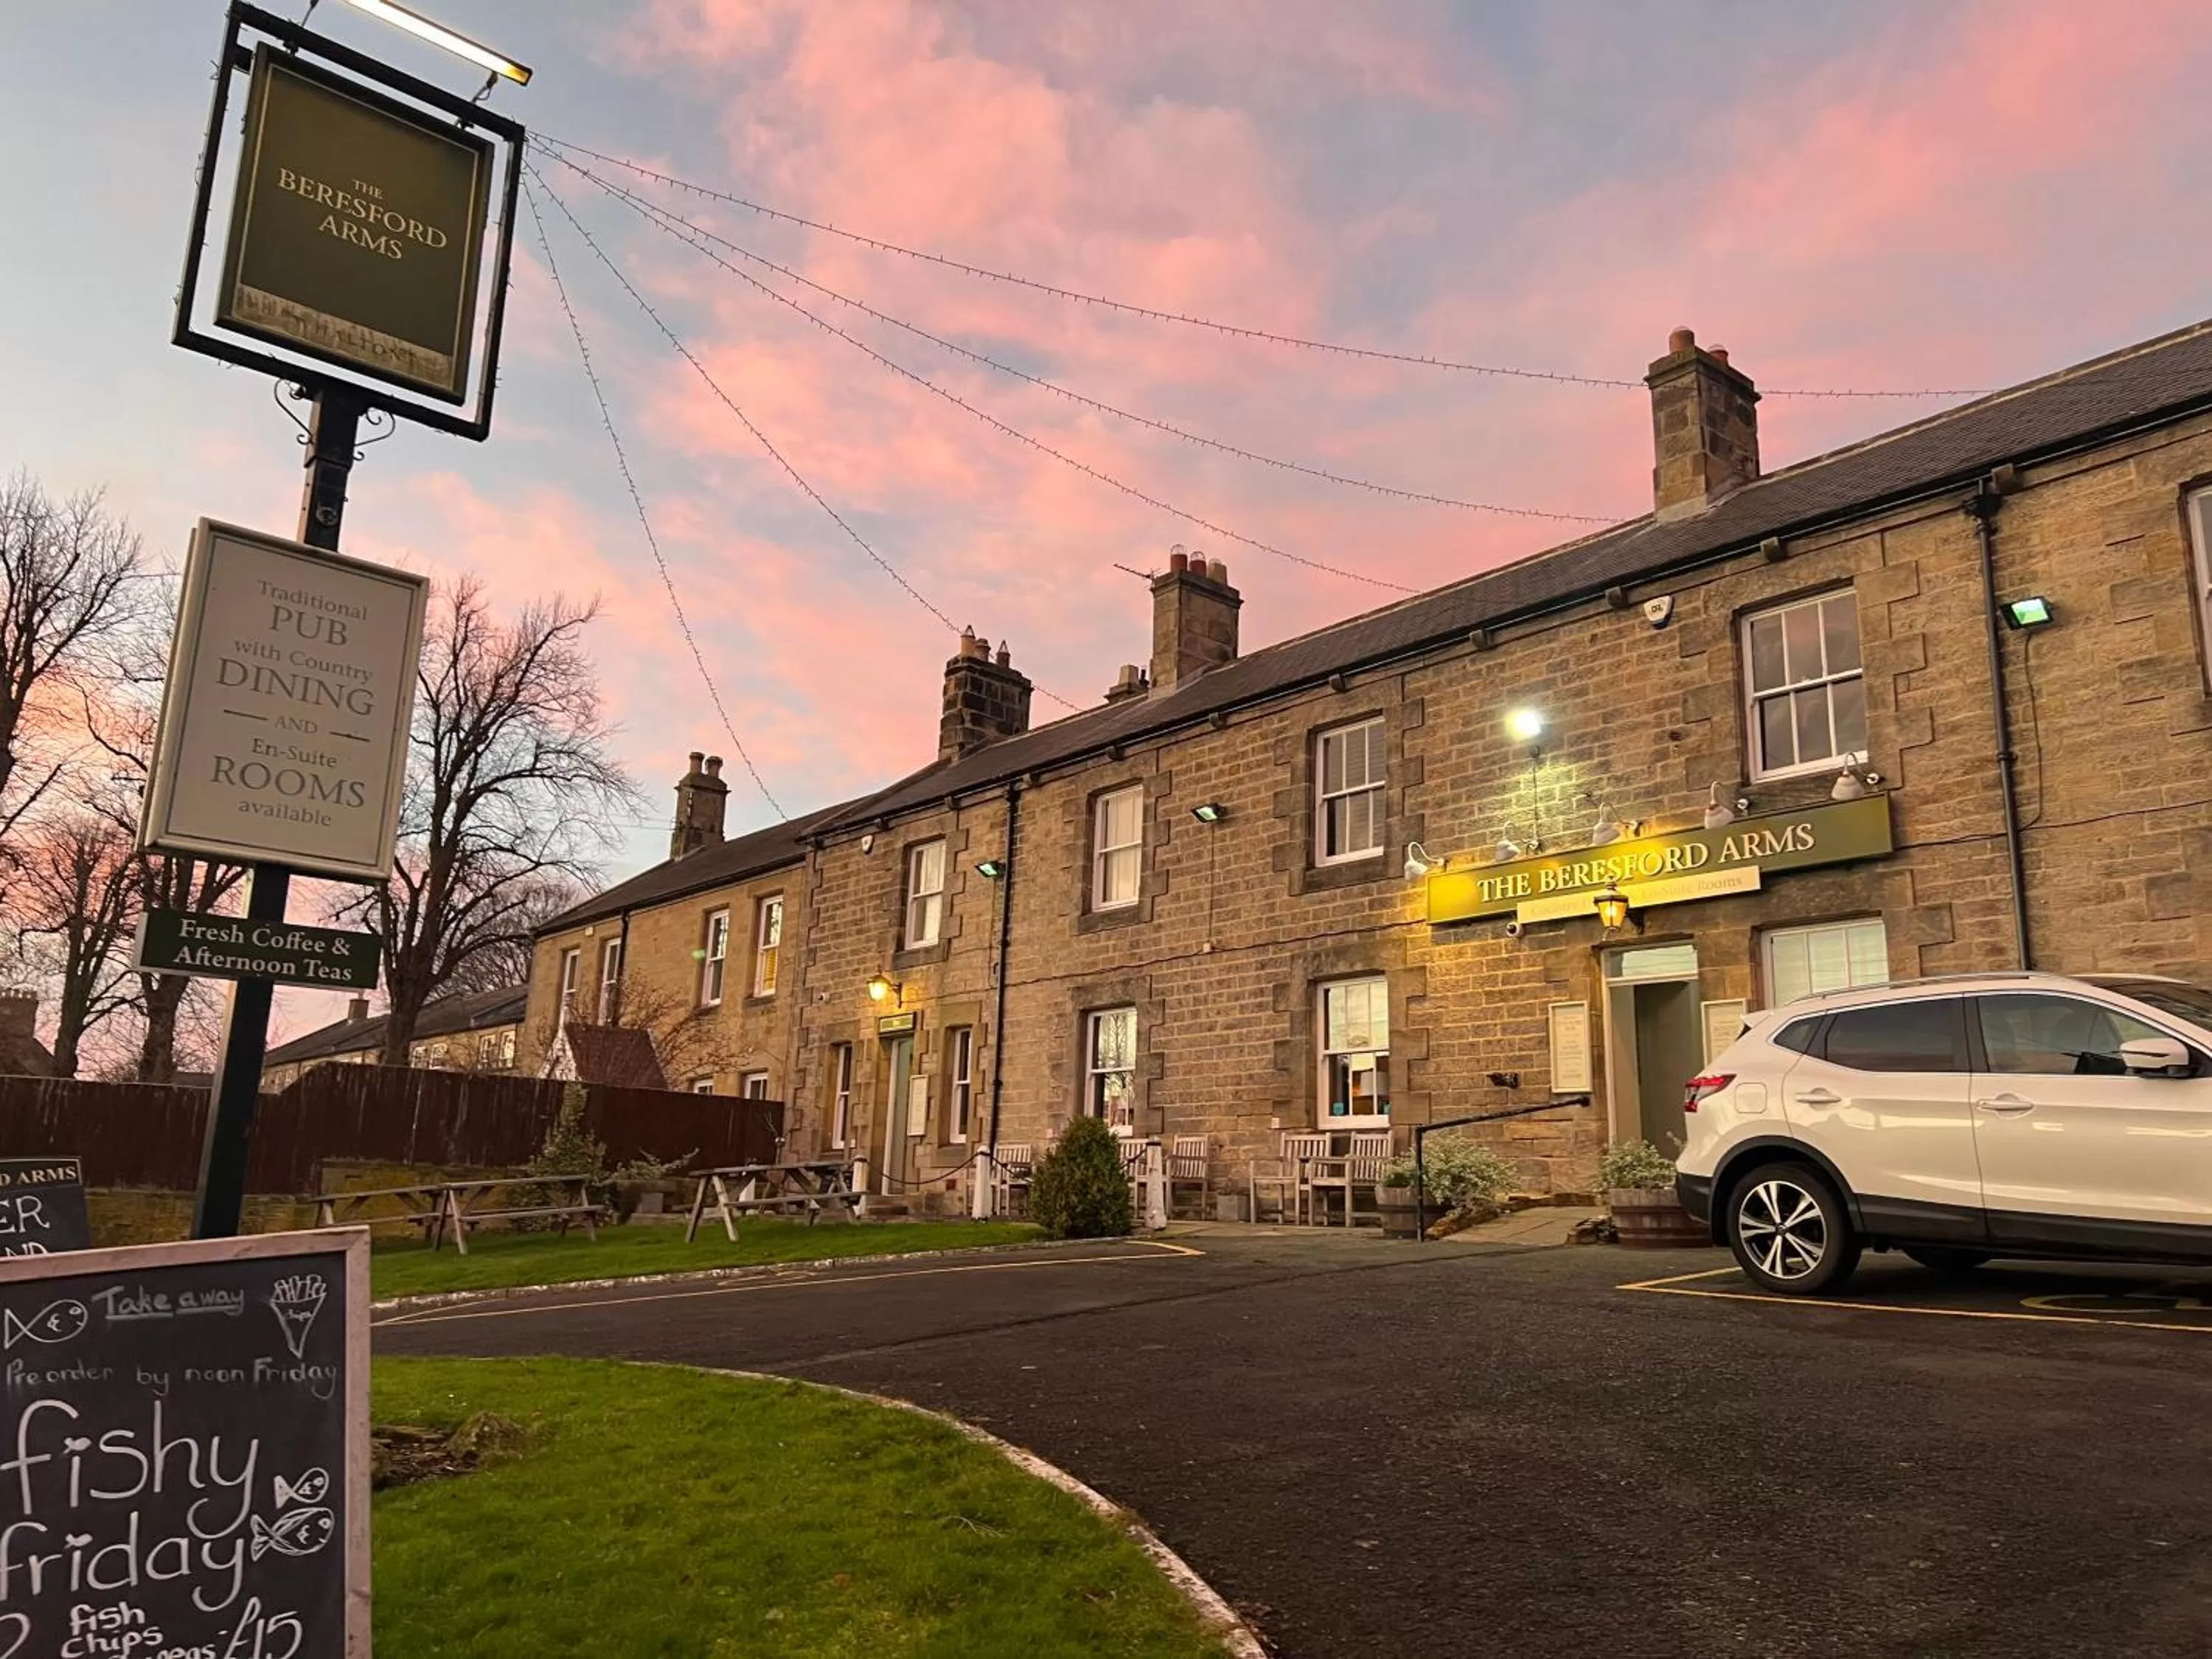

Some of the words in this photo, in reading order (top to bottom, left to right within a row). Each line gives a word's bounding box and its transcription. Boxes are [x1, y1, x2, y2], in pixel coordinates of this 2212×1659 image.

[277, 167, 448, 248] BERESFORD
[352, 178, 383, 199] THE
[318, 215, 403, 260] ARMS
[258, 580, 367, 621] Traditional
[270, 604, 347, 646] PUB
[235, 640, 281, 661] with
[289, 650, 373, 685] Country
[215, 656, 375, 716] DINING
[274, 715, 319, 734] AND
[251, 737, 337, 768] En-Suite
[210, 755, 366, 808] ROOMS
[237, 800, 331, 827] available
[1477, 872, 1532, 902] THE
[1539, 842, 1709, 894] BERESFORD
[1719, 822, 1815, 863] ARMS
[178, 918, 244, 944] Fresh
[251, 928, 326, 953] Coffee
[331, 936, 351, 956] &
[173, 945, 296, 975] Afternoon
[302, 958, 352, 981] Teas
[17, 1166, 77, 1185] ARMS
[91, 1284, 172, 1315] Take
[178, 1289, 244, 1316] away
[136, 1365, 170, 1396] by
[184, 1368, 245, 1383] noon
[253, 1357, 337, 1399] Friday
[0, 1400, 260, 1539] fishy
[0, 1511, 245, 1612] friday
[70, 1601, 146, 1635] fish
